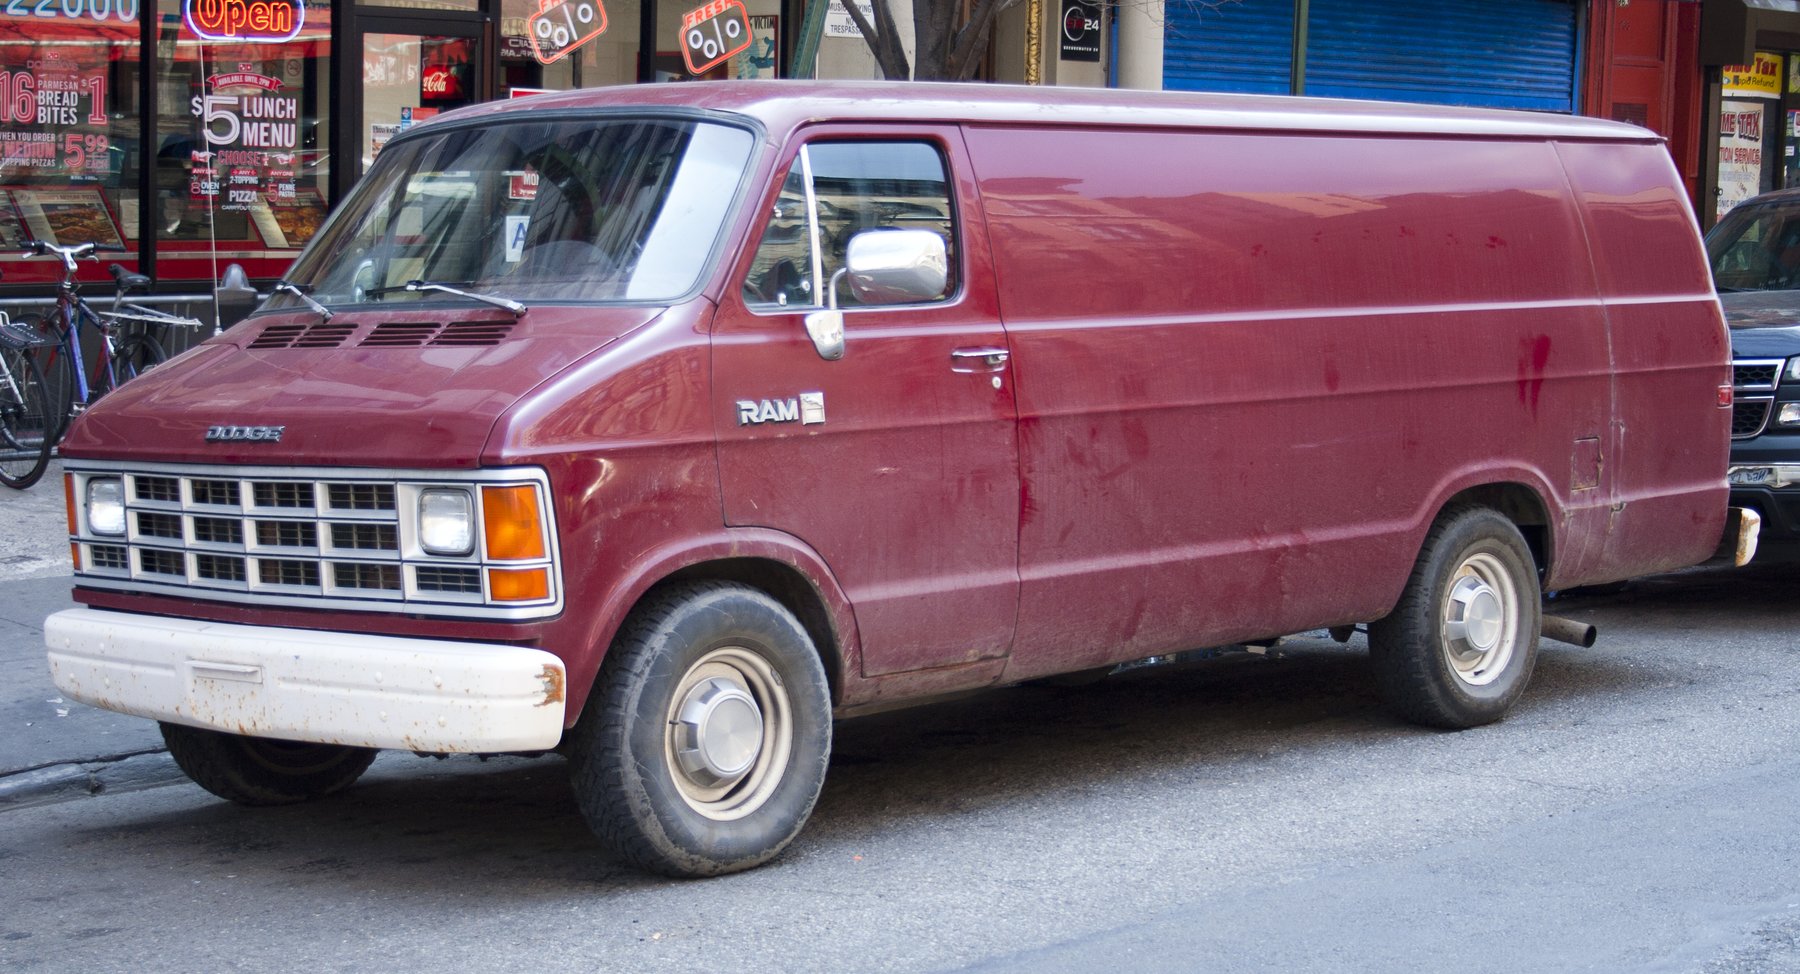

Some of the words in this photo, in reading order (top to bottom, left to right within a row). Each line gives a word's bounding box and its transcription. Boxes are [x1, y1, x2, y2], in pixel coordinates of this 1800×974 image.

[197, 0, 292, 36] Open
[685, 0, 734, 26] FRESH
[830, 24, 862, 35] TRESPASS
[1084, 19, 1099, 31] 24
[1756, 57, 1777, 76] Tax
[38, 80, 79, 90] PARMESAN
[0, 71, 35, 124] 16
[38, 90, 79, 107] BREAD
[37, 107, 78, 125] BITES
[243, 97, 297, 119] LUNCH
[1739, 111, 1761, 138] TAX
[17, 132, 32, 141] YOU
[32, 133, 56, 142] ORDER
[243, 122, 297, 148] MENU
[5, 141, 56, 158] MEDIUM
[1734, 147, 1761, 166] SERVICE
[31, 159, 56, 168] PIZZAS
[217, 151, 261, 166] CHOOSE
[200, 181, 220, 189] OVEN
[229, 190, 258, 202] PIZZA
[511, 222, 528, 250] A
[736, 398, 799, 425] RAM
[204, 425, 286, 442] DODGE
